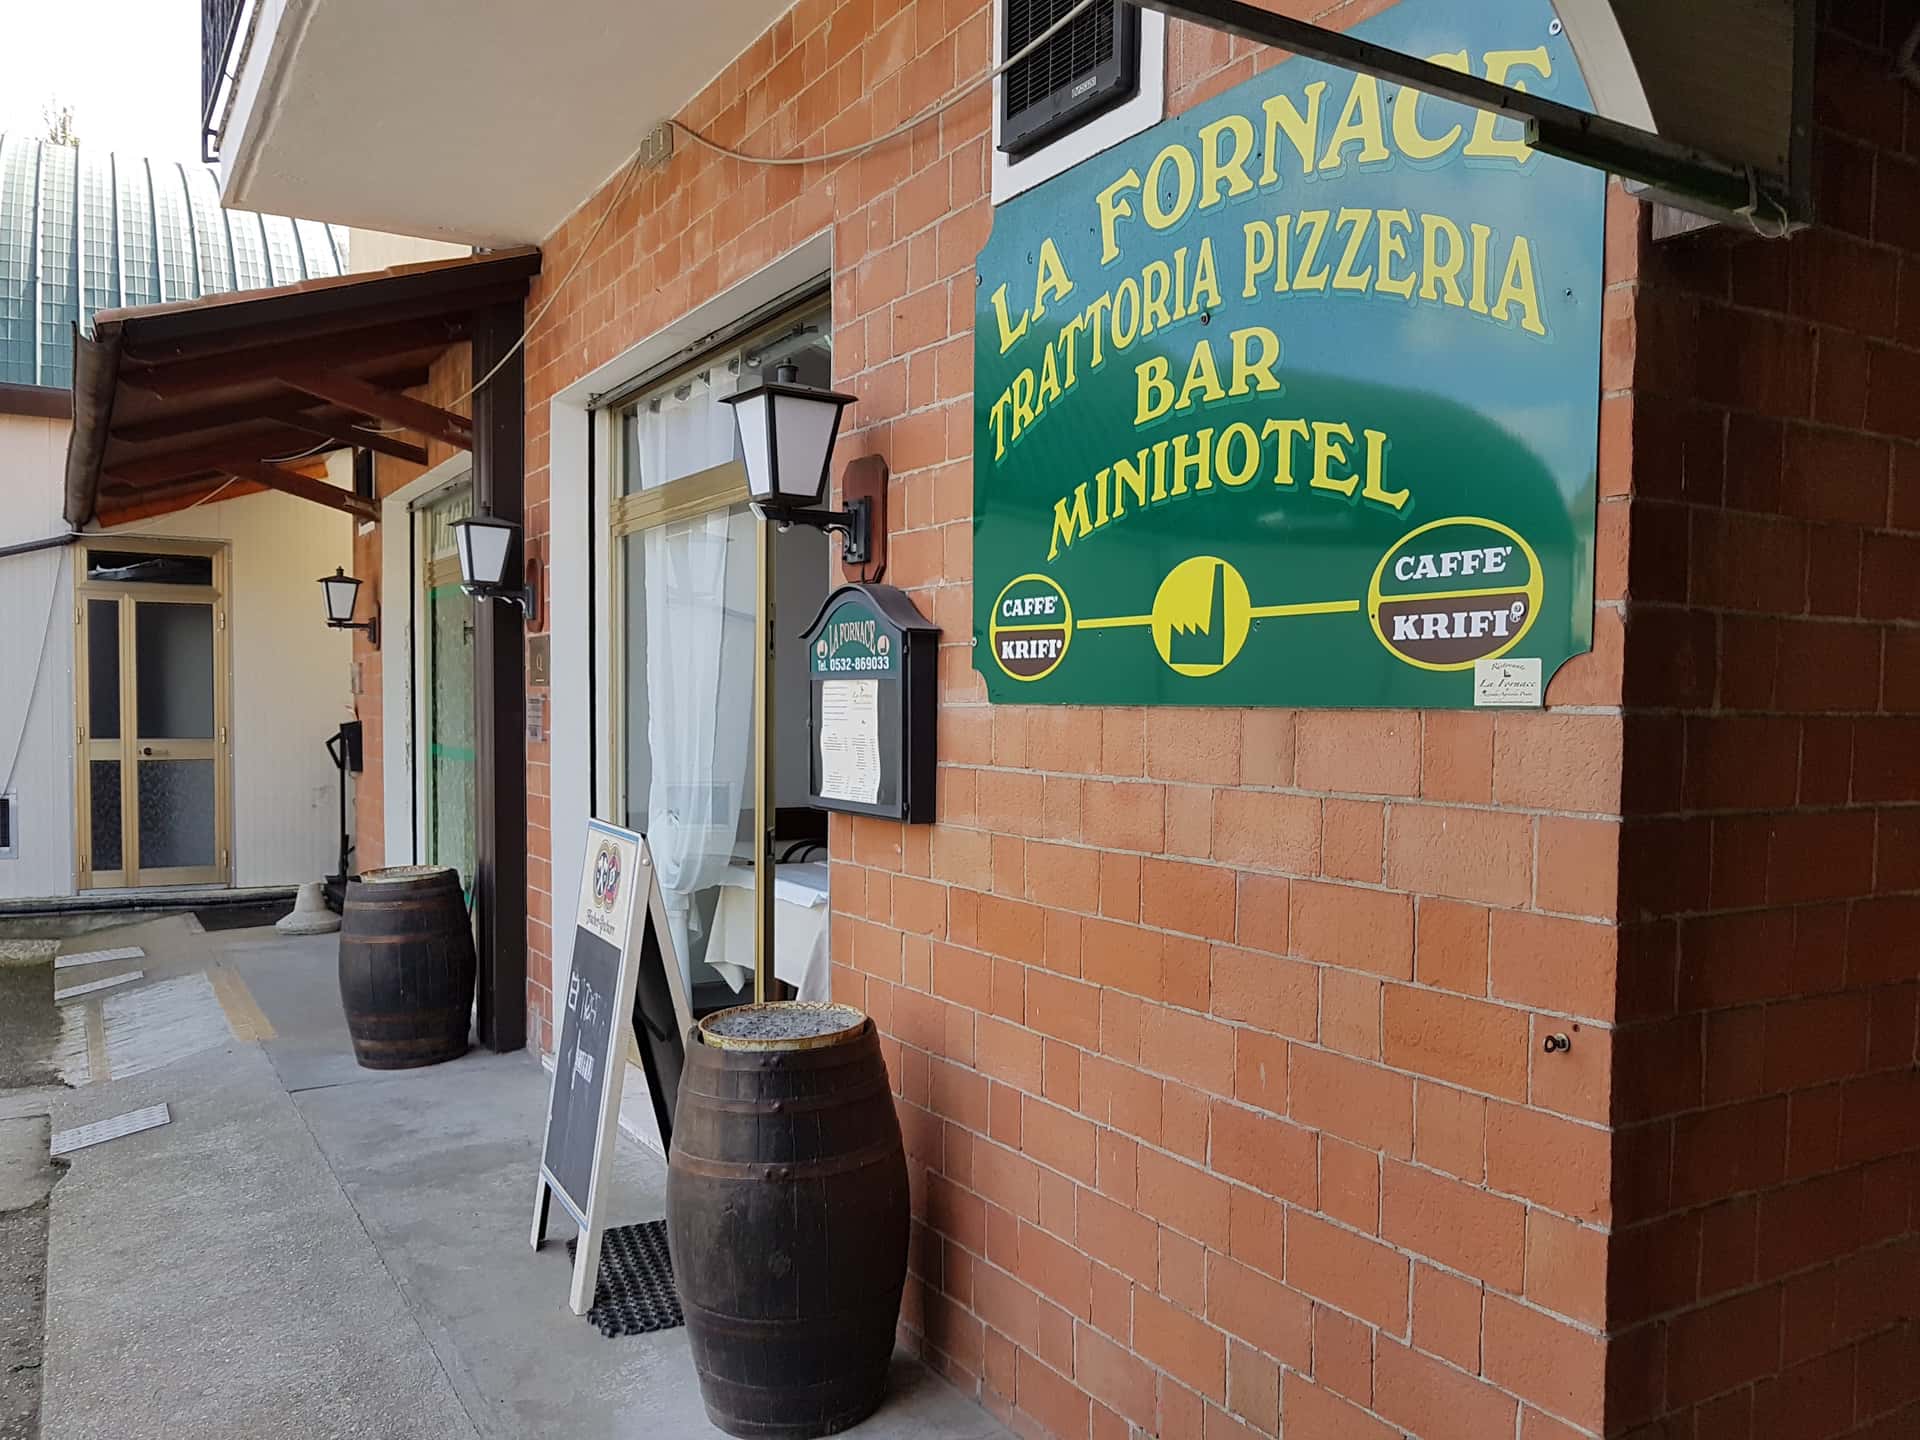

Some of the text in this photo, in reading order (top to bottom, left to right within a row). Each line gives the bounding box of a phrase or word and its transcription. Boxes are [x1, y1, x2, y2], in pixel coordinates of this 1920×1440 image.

[991, 47, 1552, 354] LA FORNACE
[990, 208, 1547, 460] TRATTORIA PIZZERIA
[1135, 327, 1282, 426] BAR
[1048, 419, 1411, 561] MINIHOTEL
[1395, 546, 1512, 581] CAFFE'
[817, 656, 890, 672] Tel. 0532-869033
[828, 620, 877, 658] LA FORNACE
